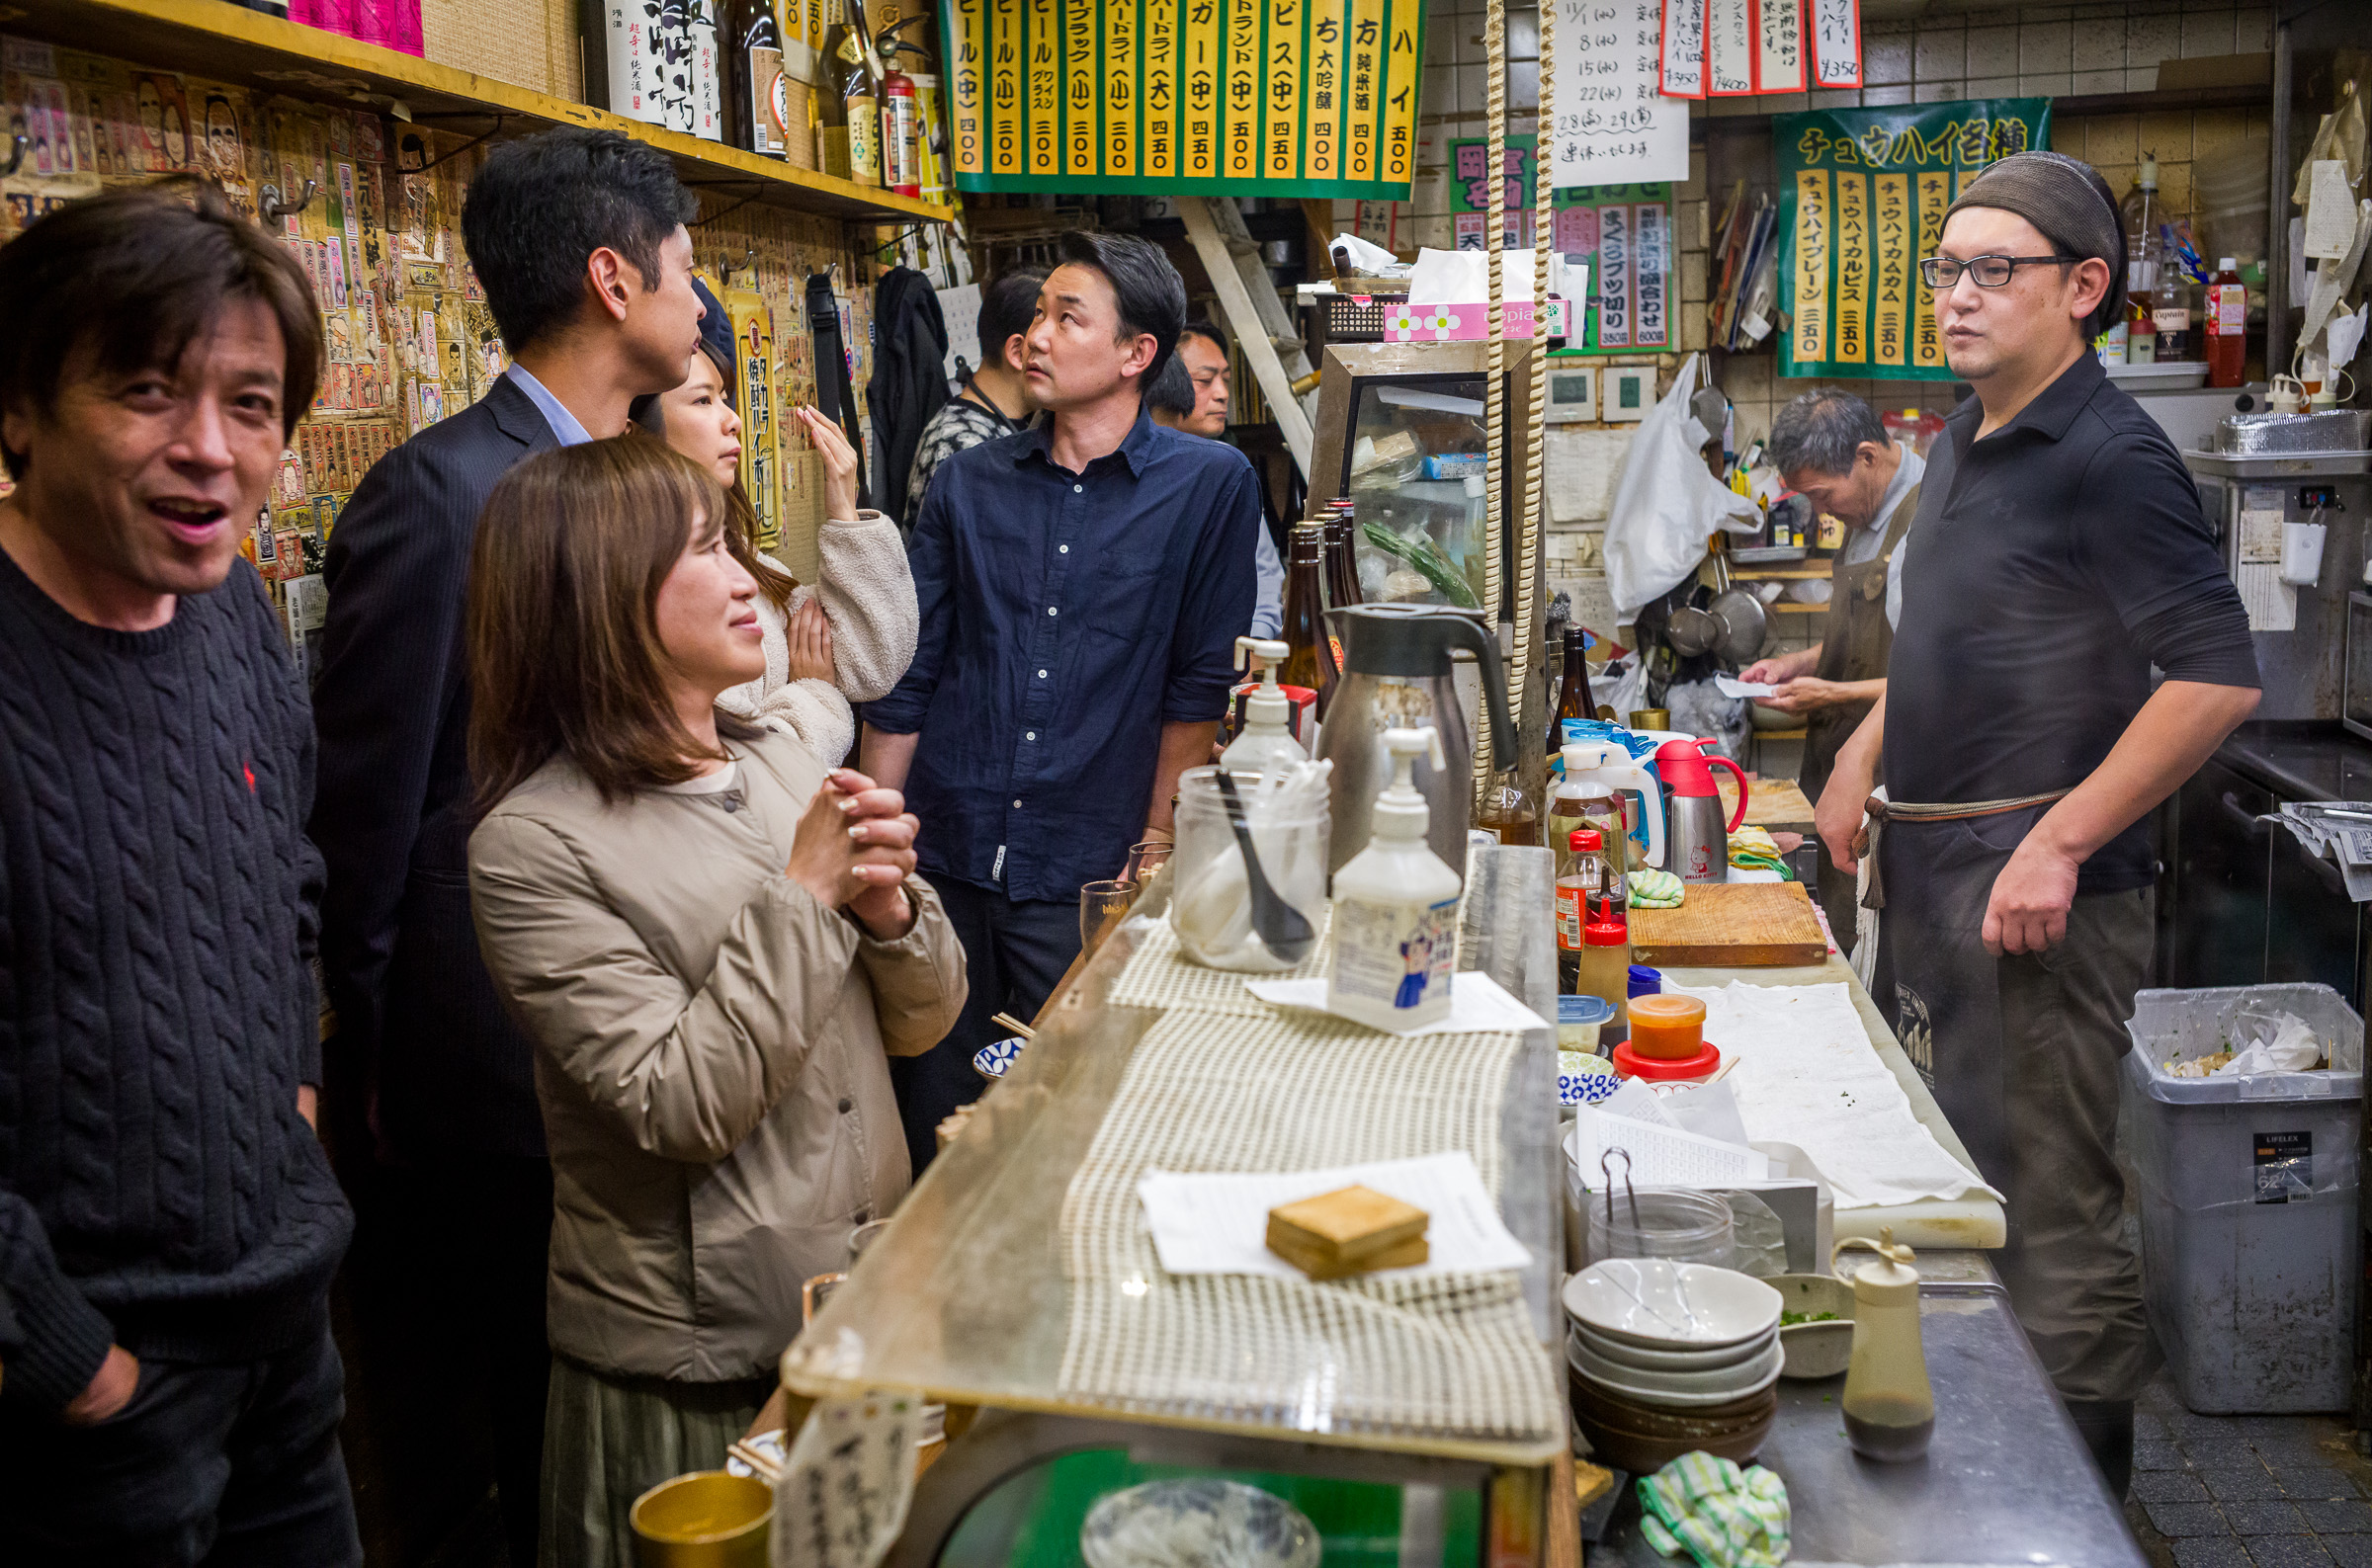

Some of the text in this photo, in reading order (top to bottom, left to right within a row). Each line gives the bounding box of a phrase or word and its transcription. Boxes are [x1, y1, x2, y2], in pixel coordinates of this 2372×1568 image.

[612, 9, 623, 28] 清酒
[629, 23, 640, 56] 超辛口
[631, 60, 641, 91] 純米酒
[702, 47, 711, 77] 超辛口
[1798, 118, 2027, 167] チュウハイ各種
[759, 357, 769, 434] タカラ
